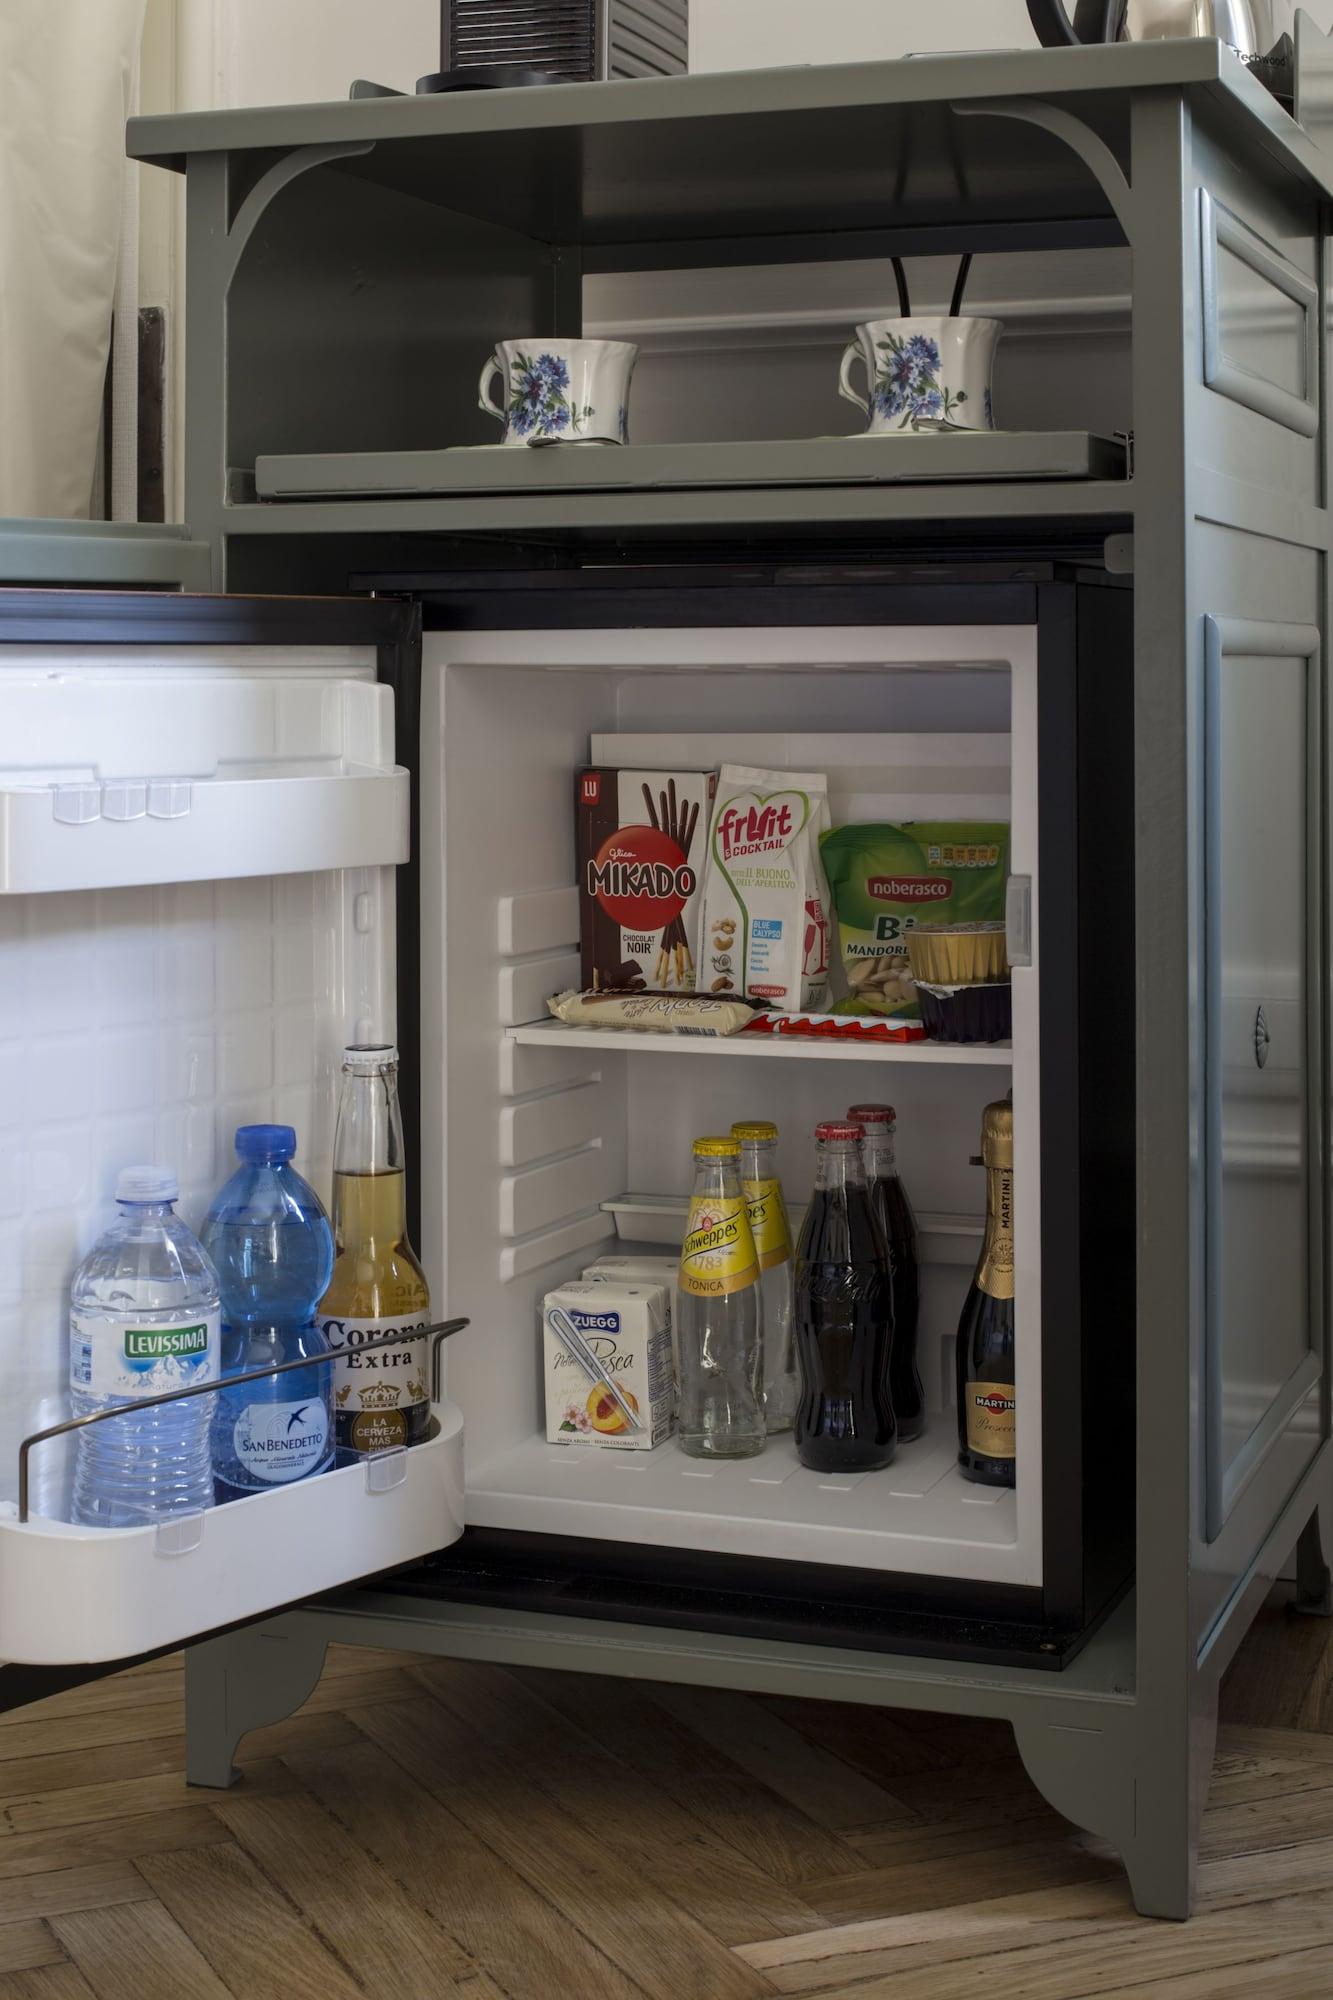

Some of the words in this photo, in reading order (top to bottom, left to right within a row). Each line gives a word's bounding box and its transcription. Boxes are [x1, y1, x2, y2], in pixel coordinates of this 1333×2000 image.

[584, 782, 597, 796] LU
[733, 839, 784, 857] COCKTAIL
[587, 860, 697, 898] MIKADO
[756, 867, 791, 880] BUONO
[873, 880, 948, 896] noberasco
[753, 921, 770, 930] BLUE
[622, 934, 656, 943] CHOCOLAT
[752, 929, 781, 938] CALYPSO
[627, 942, 652, 954] NOIR
[847, 944, 909, 955] MANDORL
[751, 986, 785, 995] noberasco
[1001, 1178, 1011, 1229] MARTINI
[683, 1221, 738, 1253] Schweppes
[693, 1255, 722, 1271] 1783
[687, 1278, 724, 1292] TONICA
[573, 1316, 617, 1328] ZUEGG
[129, 1328, 205, 1354] LEVISSIMA
[346, 1352, 412, 1369] Extra
[976, 1396, 1015, 1409] MARTIN
[372, 1418, 387, 1427] LA
[356, 1425, 402, 1437] CERVEZA
[368, 1436, 391, 1446] MAS
